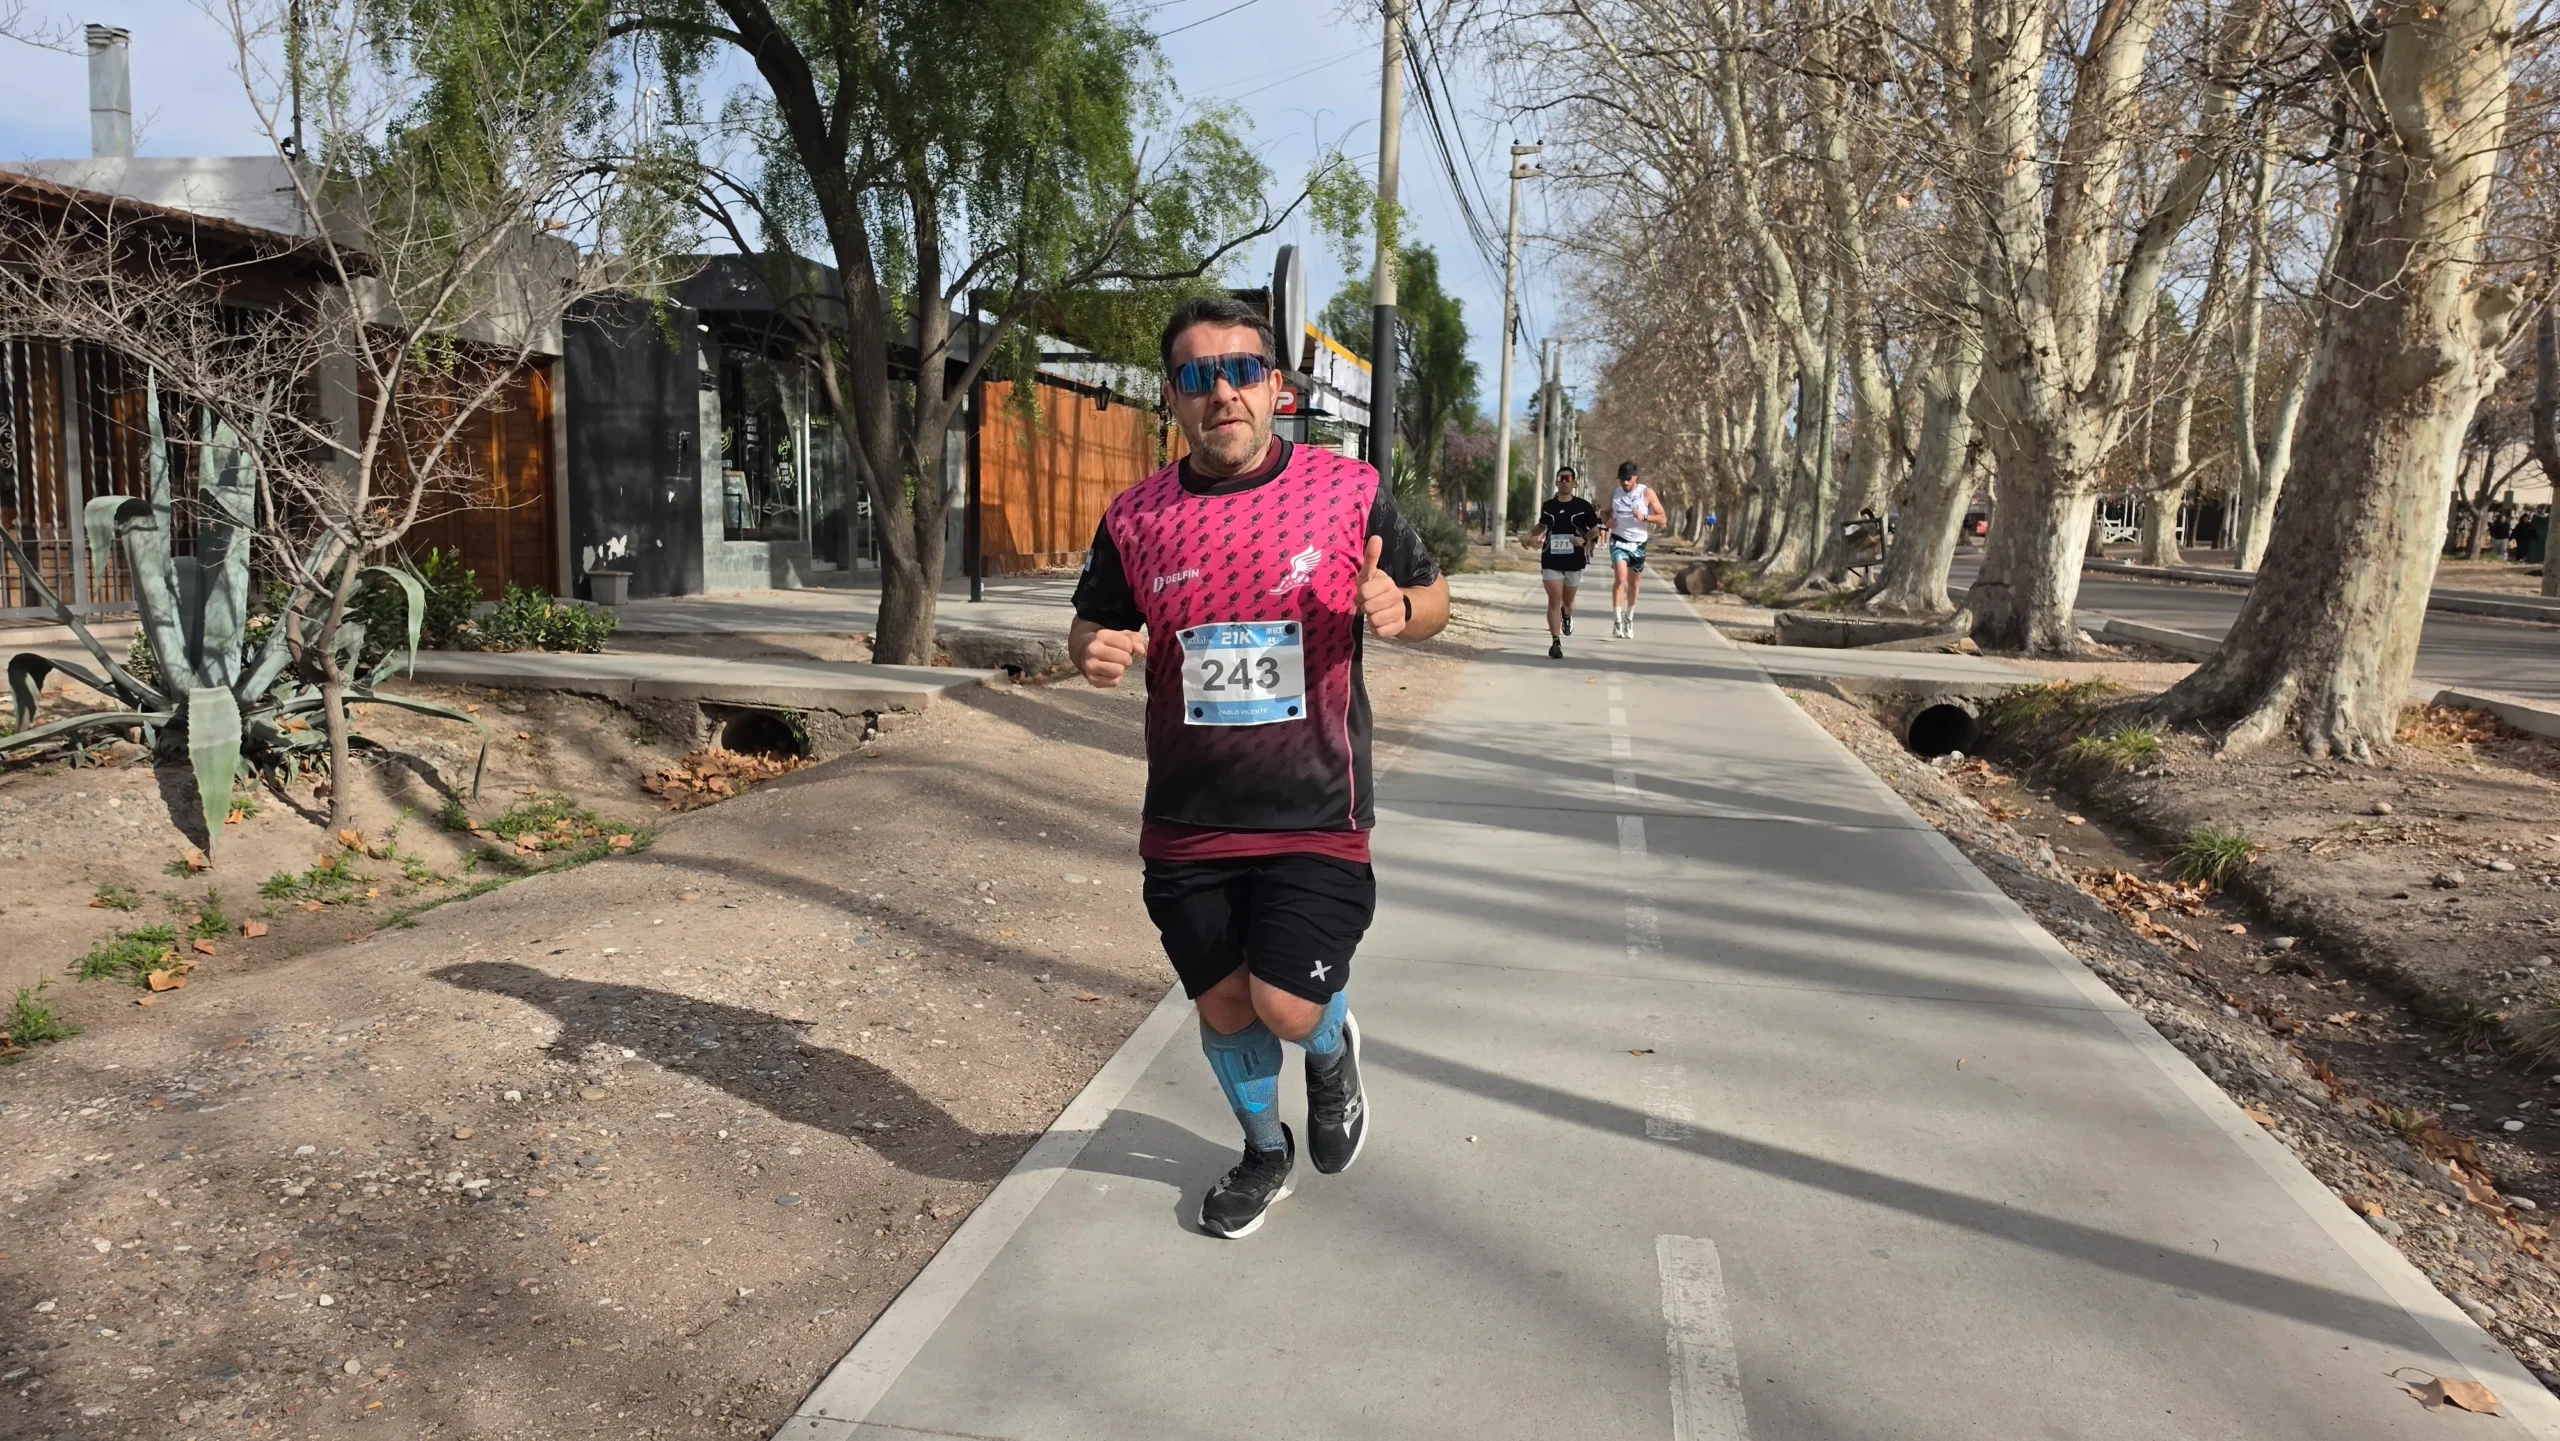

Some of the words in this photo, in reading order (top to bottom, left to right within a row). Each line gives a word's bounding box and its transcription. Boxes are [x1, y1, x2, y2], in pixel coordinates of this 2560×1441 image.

[1554, 540, 1569, 549] 271
[1165, 567, 1200, 585] DELFÍN
[1221, 631, 1252, 645] 21K
[1201, 657, 1281, 692] 243
[1240, 707, 1268, 716] VICENTE
